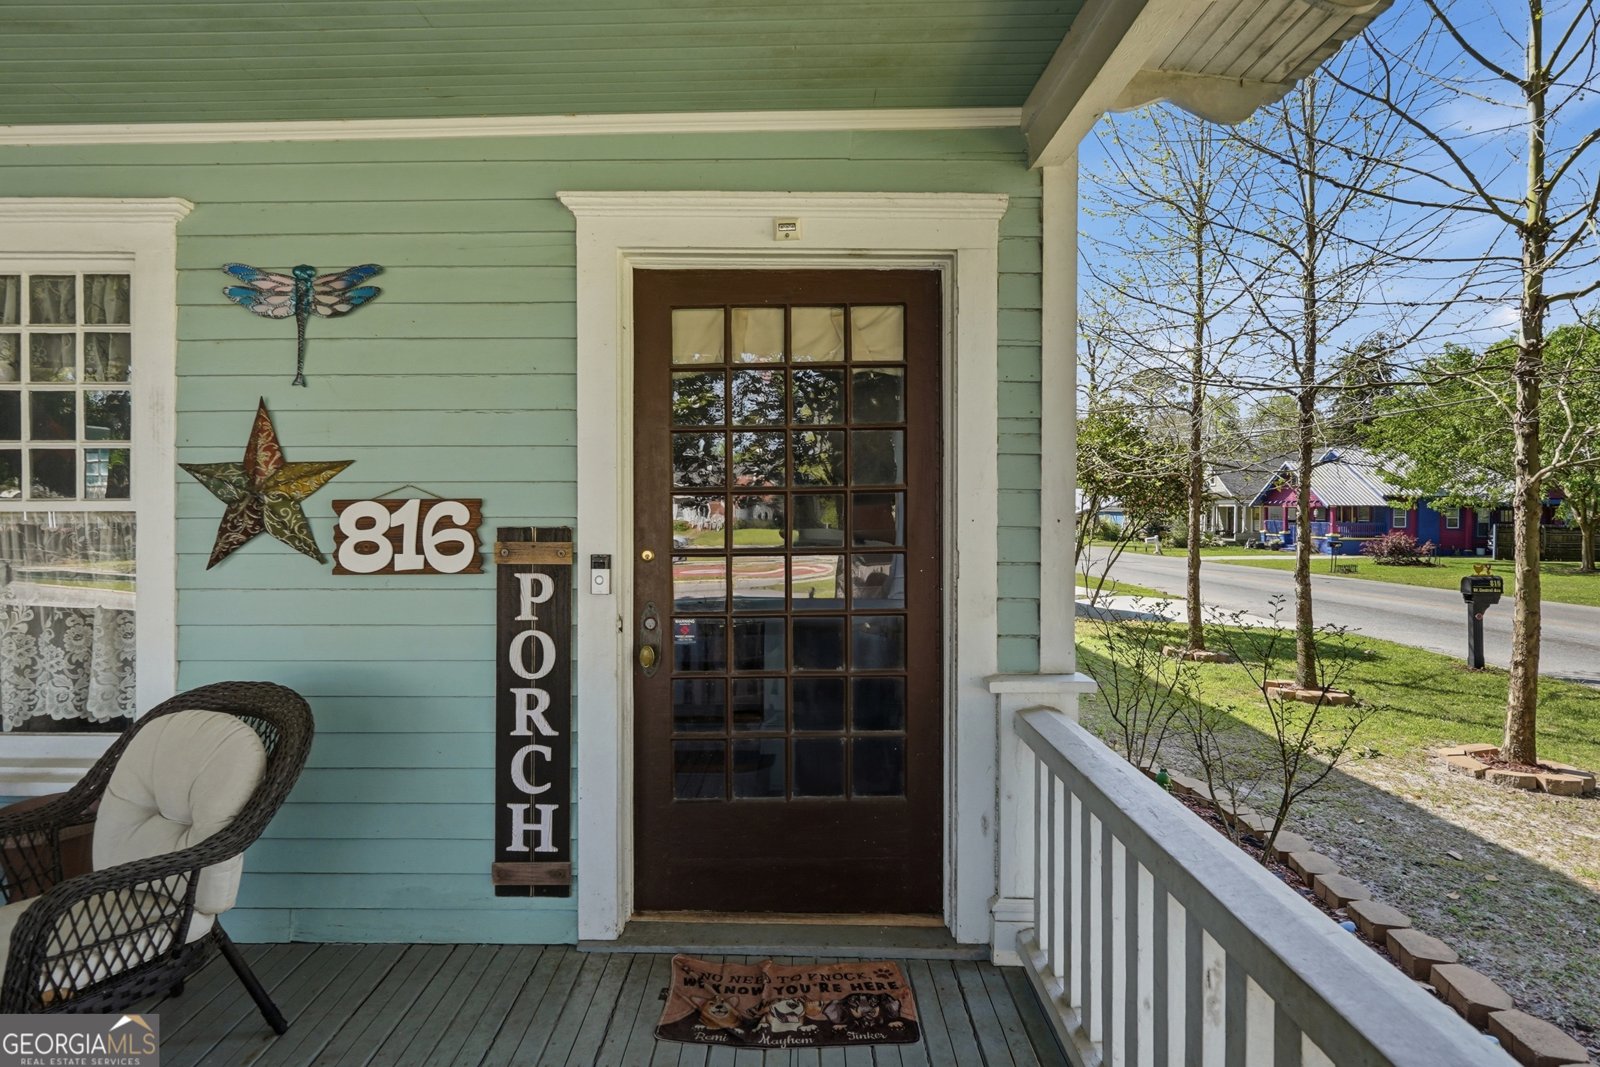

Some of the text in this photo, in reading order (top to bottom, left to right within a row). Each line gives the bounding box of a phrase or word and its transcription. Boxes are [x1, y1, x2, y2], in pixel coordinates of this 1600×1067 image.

[338, 498, 475, 573] 816
[505, 572, 559, 853] PORCH
[683, 976, 900, 996] WE KNOW YOU'RE HERE
[700, 971, 724, 983] NO
[776, 973, 803, 984] TO
[758, 1031, 815, 1048] Mayhem
